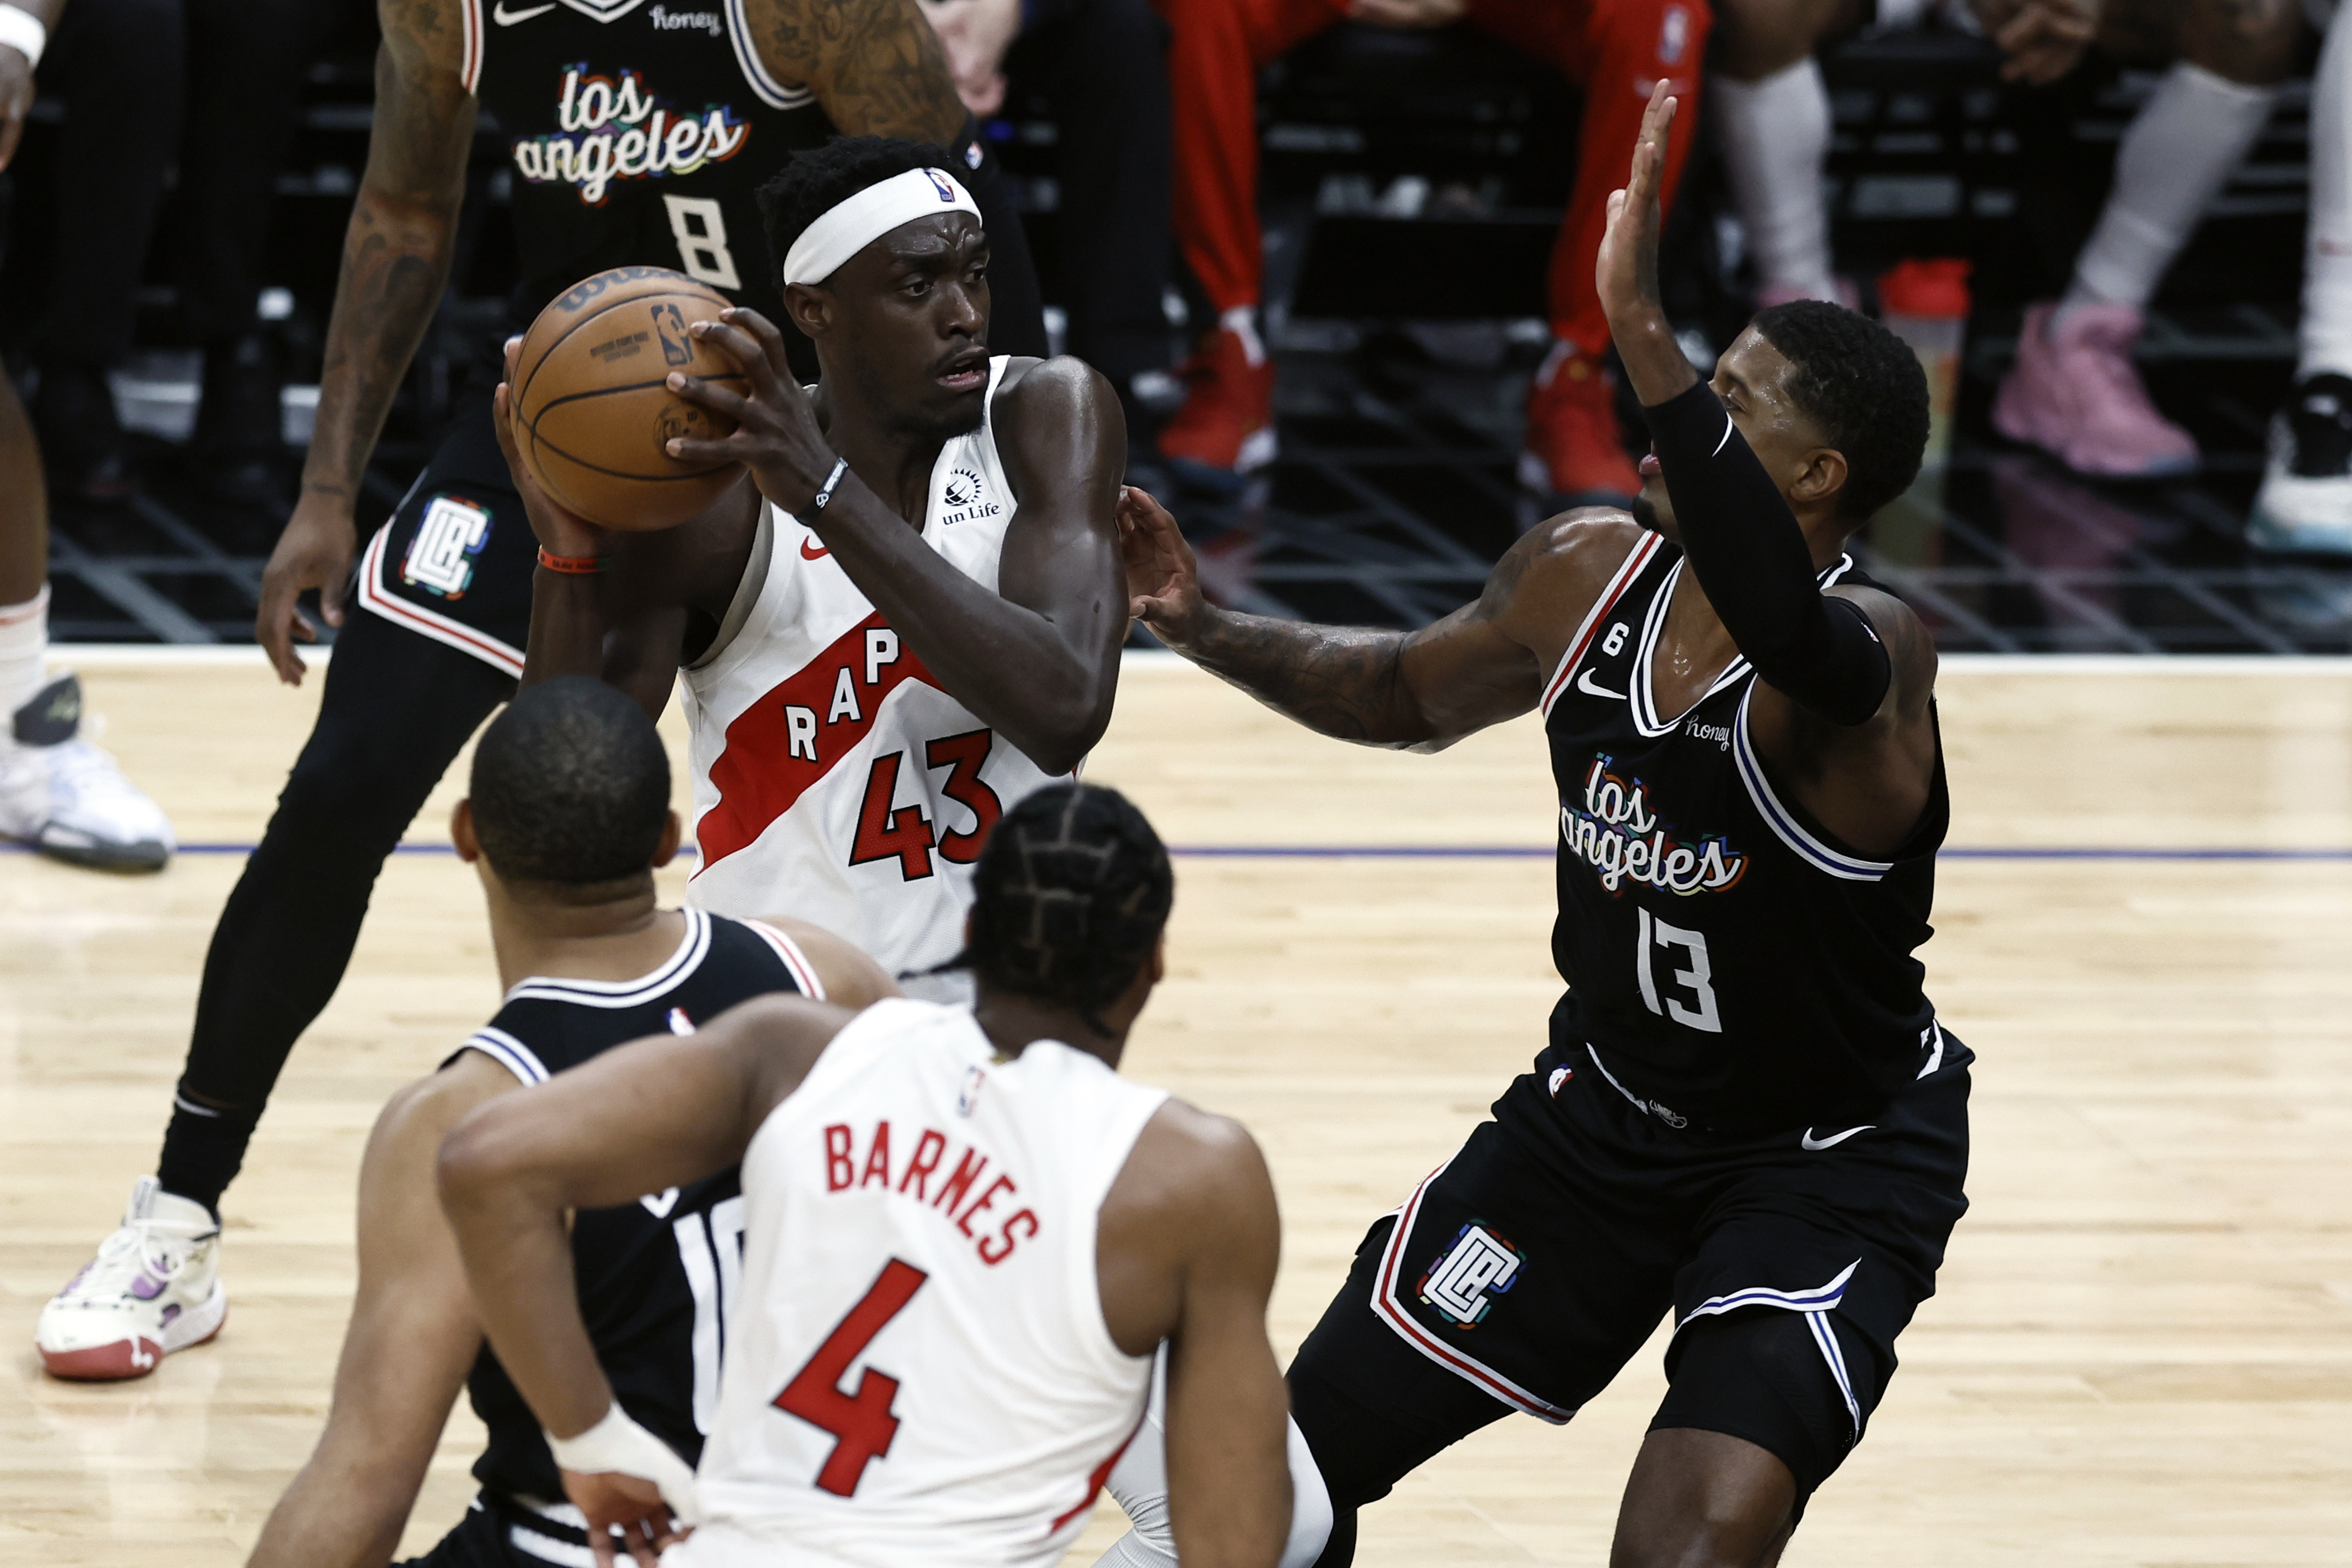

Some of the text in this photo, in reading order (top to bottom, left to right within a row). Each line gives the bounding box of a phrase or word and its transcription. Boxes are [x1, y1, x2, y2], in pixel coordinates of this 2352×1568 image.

[648, 4, 723, 37] honey
[558, 70, 654, 132] los
[516, 109, 744, 203] angeles
[663, 194, 742, 291] 8
[943, 502, 1001, 525] un Life
[1602, 622, 1629, 657] 6
[784, 626, 900, 764] RAP
[1685, 714, 1730, 751] honey
[849, 727, 1003, 882] 43
[1585, 760, 1656, 834] los
[1561, 803, 1741, 891] angeles
[1637, 906, 1723, 1033] 13
[823, 1120, 1040, 1266] BARNES
[771, 1257, 928, 1498] 4
